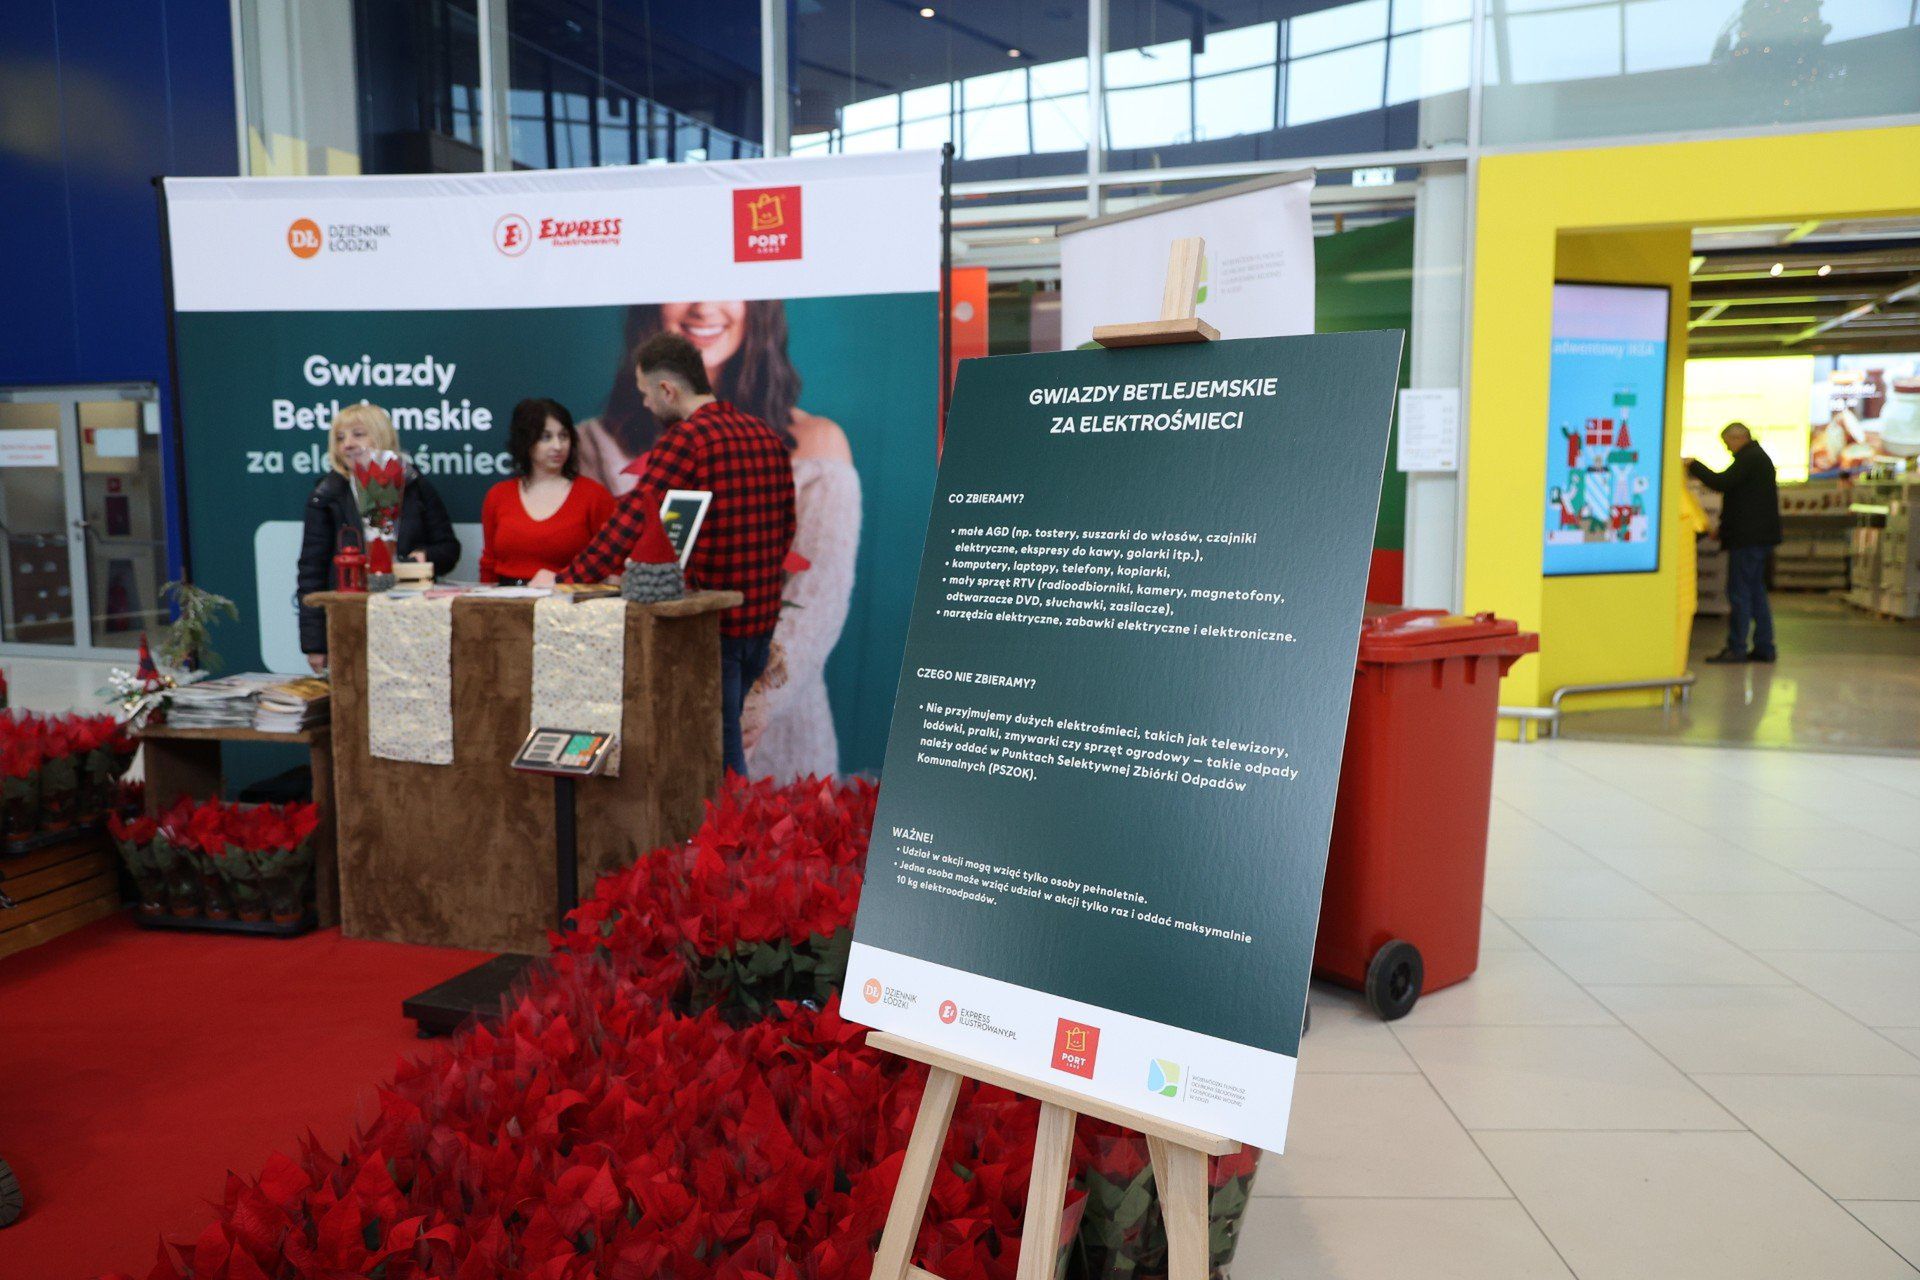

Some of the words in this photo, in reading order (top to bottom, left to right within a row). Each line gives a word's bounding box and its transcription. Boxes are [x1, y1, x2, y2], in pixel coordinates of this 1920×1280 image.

[328, 224, 391, 238] DZIENNIK
[748, 233, 788, 248] PORT
[303, 354, 456, 394] Gwiazdy
[1029, 384, 1120, 405] GWIAZDY
[1122, 377, 1278, 401] BETLEJEMSKIE
[272, 399, 493, 431] Betlmskie
[1050, 416, 1075, 434] ZA
[1079, 408, 1244, 433] ELEKTROŚMIECI
[246, 450, 284, 473] za
[948, 493, 964, 504] CO
[965, 493, 1025, 504] ZBIERAMY?
[958, 526, 984, 536] małe
[985, 526, 1010, 537] AGD
[1011, 526, 1032, 539] (np.
[1035, 528, 1079, 541] tostery,
[1082, 529, 1131, 540] suszarki
[1132, 530, 1148, 541] do
[1151, 530, 1203, 543] włosów,
[1206, 532, 1257, 546] czajniki
[954, 542, 1018, 555] elektryczne,
[1020, 544, 1070, 558] ekspresy
[1071, 545, 1086, 556] do
[1089, 546, 1124, 560] kawy,
[1126, 548, 1170, 560] golarki
[1172, 549, 1203, 563] itp.),
[952, 558, 1011, 572] komputery,
[1013, 560, 1059, 574] laptopy,
[1062, 563, 1114, 577] telefony,
[1117, 565, 1170, 579] kopiarki,
[949, 575, 976, 588] mały
[977, 578, 1011, 589] sprzęt
[1013, 577, 1036, 588] RTV
[1037, 578, 1133, 595] (radioodbiorniki,
[1136, 584, 1187, 599] kamery,
[1190, 589, 1285, 605] magnetofony,
[946, 591, 1013, 604] odtwarzacze
[1015, 594, 1043, 608] DVD,
[1045, 597, 1106, 612] słuchawki,
[1109, 601, 1174, 616] zasilacze),
[943, 609, 993, 621] narzędzia
[995, 611, 1063, 626] elektryczne,
[1065, 616, 1115, 629] zabawki
[1117, 619, 1190, 635] elektryczne
[1193, 624, 1198, 635] i
[1200, 625, 1297, 643] elektroniczne.
[916, 667, 953, 680] CZEGO
[954, 671, 973, 683] NIE
[974, 673, 1036, 689] ZBIERAMY?
[926, 702, 943, 714] Nie
[944, 707, 1013, 725] przyjmujemy
[1014, 713, 1054, 728] dużych
[1056, 719, 1141, 740] elektrośmieci,
[1144, 729, 1184, 744] takich
[1186, 733, 1208, 747] jak
[1211, 738, 1288, 758] telewizory,
[923, 719, 965, 735] lodówki,
[967, 727, 1002, 740] pralki,
[1004, 732, 1060, 746] zmywarki
[1061, 740, 1082, 752] czy
[1084, 742, 1123, 757] sprzęt
[1125, 748, 1190, 766] ogrodowy
[1206, 757, 1241, 771] takie
[1245, 762, 1298, 781] odpady
[917, 752, 986, 772] Komunalnych
[988, 762, 1037, 781] (PSZOK).
[920, 737, 953, 752] należy
[955, 742, 988, 755] oddać
[990, 748, 1000, 756] w
[1001, 747, 1054, 764] Punktach
[1057, 754, 1131, 778] Selektywnej
[1132, 765, 1179, 782] Zbiórki
[1181, 772, 1247, 791] Odpadów
[893, 826, 934, 844] WAŻNE!
[902, 845, 931, 859] Udział
[942, 854, 964, 867] akcji
[965, 860, 991, 874] mogą
[993, 866, 1021, 879] wziąć
[1023, 871, 1048, 884] tylko
[1050, 878, 1081, 892] osoby
[1082, 884, 1147, 904] pełnoletnie.
[897, 874, 906, 884] 10
[907, 877, 918, 889] kg
[920, 881, 997, 905] elektroodpadów.
[899, 860, 925, 873] Jedna
[926, 868, 953, 879] osoba
[955, 874, 979, 885] może
[981, 879, 1009, 893] wziąć
[1011, 885, 1042, 898] udział
[1043, 893, 1053, 901] w
[1054, 894, 1080, 908] akcji
[1081, 899, 1109, 913] tylko
[1111, 907, 1129, 917] raz
[1131, 909, 1135, 918] i
[1137, 912, 1172, 927] oddać
[1174, 920, 1252, 943] maksymalnie
[885, 986, 919, 1004] DZIENNIK
[958, 1016, 1018, 1041] ILUSTROWANY.PL
[960, 1008, 991, 1024] EXPRESS
[1061, 1052, 1087, 1066] PORT
